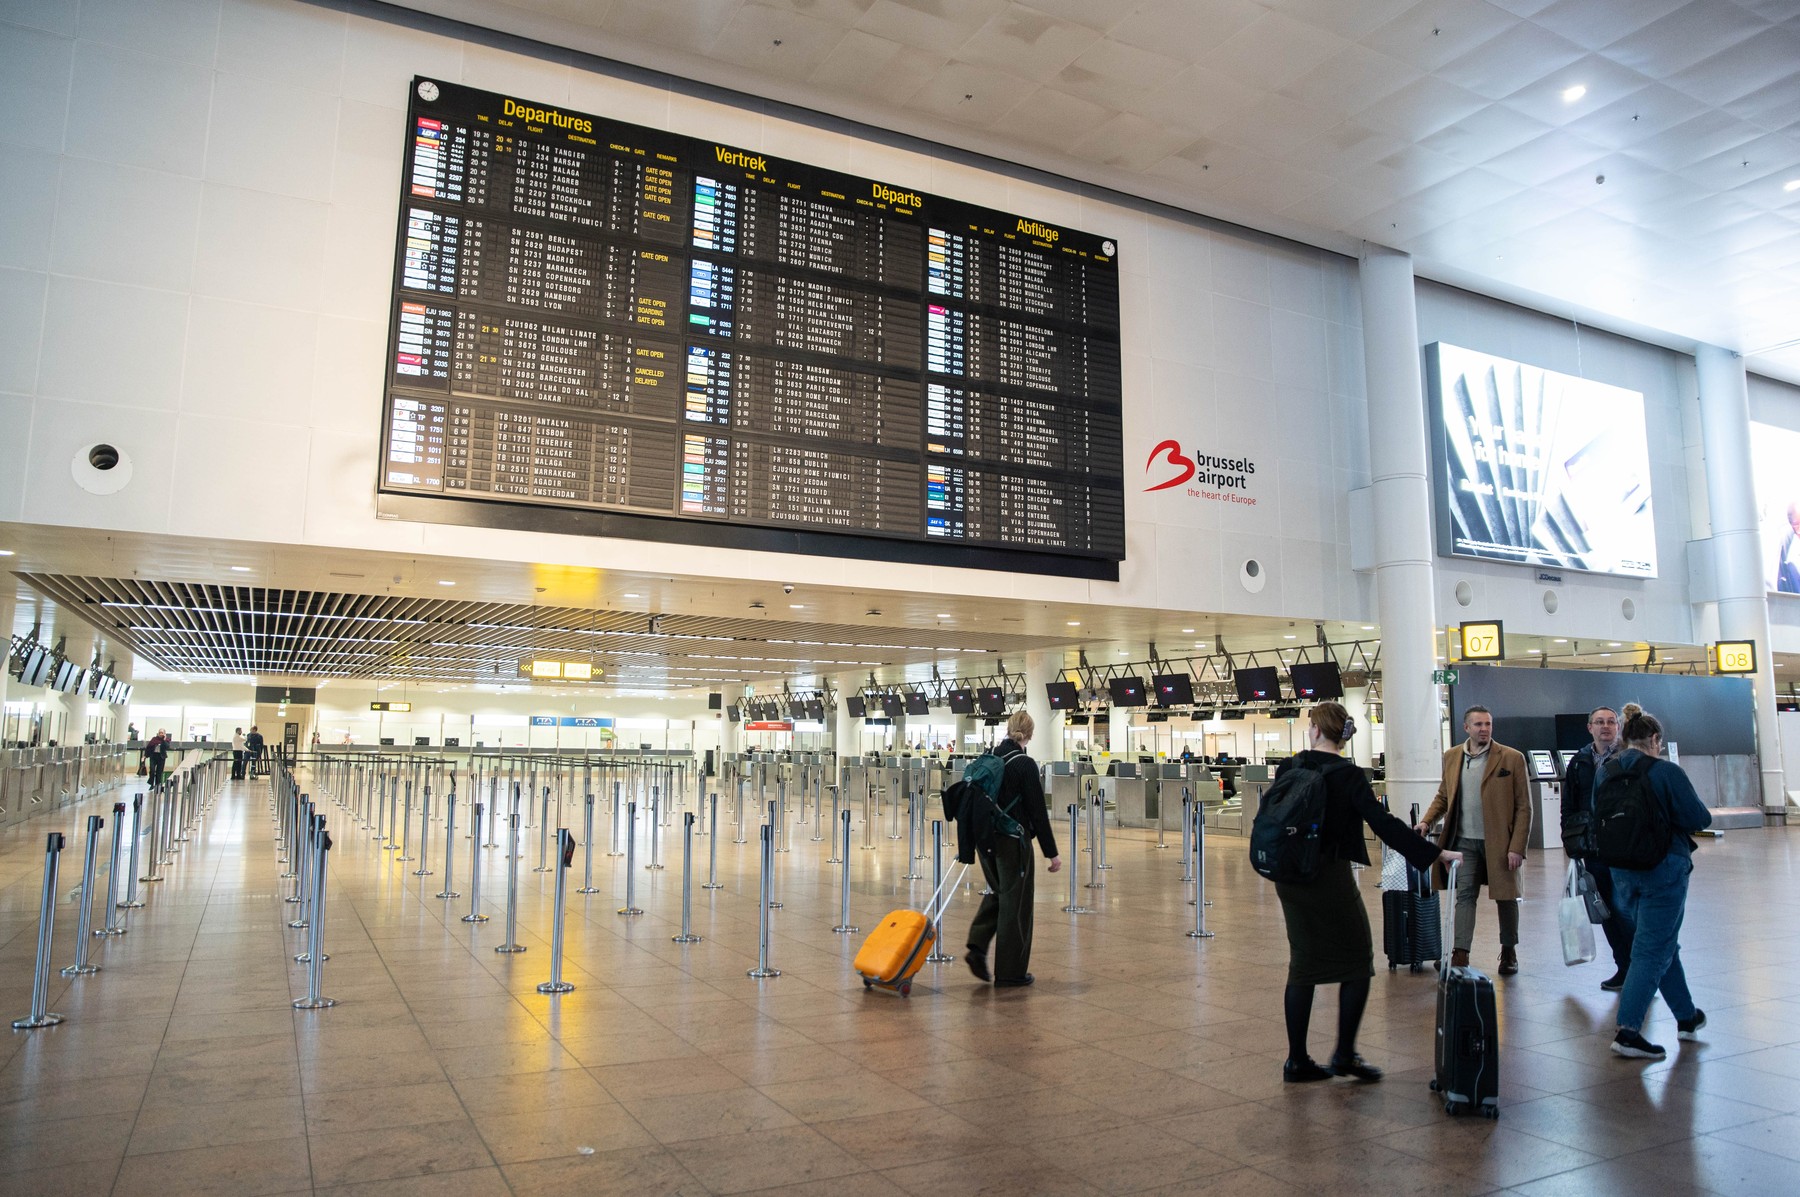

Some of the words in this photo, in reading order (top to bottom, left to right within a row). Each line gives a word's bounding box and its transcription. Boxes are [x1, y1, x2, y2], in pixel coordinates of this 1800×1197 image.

[504, 99, 592, 134] Departures
[477, 114, 489, 122] TIME
[498, 119, 513, 127] DELAY
[568, 134, 596, 145] DESTINATION
[610, 143, 630, 153] CHECK-IN
[634, 148, 646, 156] GATE
[656, 153, 677, 162] REMARKS
[554, 148, 585, 160] TANGIER
[715, 146, 767, 172] Vertrek
[553, 157, 580, 168] WARSAW
[552, 166, 580, 177] MALAGA
[646, 166, 658, 175] GATE
[659, 168, 672, 178] OPEN
[553, 175, 579, 186] ZAGREB
[552, 184, 578, 195] PRAGUE
[551, 193, 592, 206] STOCKHOLM
[872, 183, 922, 208] Départs
[550, 203, 578, 213] WARSAW
[810, 202, 833, 213] GENEVA
[550, 212, 568, 221] ROME
[572, 216, 602, 227] FIUMICI
[810, 211, 829, 221] MILAN
[832, 216, 855, 226] MALPEN
[810, 220, 833, 230] AGADIR
[1017, 218, 1059, 242] Abflüge
[810, 228, 829, 237] PARIS
[548, 235, 576, 246] BERLIN
[810, 236, 832, 246] VIENNA
[547, 245, 583, 256] BUDAPEST
[810, 244, 832, 255] ZURICH
[546, 254, 574, 264] MADRID
[809, 253, 832, 263] MUNICH
[546, 263, 587, 276] MARRAKECH
[809, 262, 843, 274] FRANKFURT
[546, 273, 590, 286] COPENHAGEN
[545, 282, 581, 294] GOTEBORG
[808, 283, 831, 292] MADRID
[544, 292, 576, 303] HAMBURG
[808, 291, 823, 301] ROME
[827, 295, 853, 306] FIUMICI
[544, 302, 562, 310] LYON
[808, 300, 838, 311] HELSINKI
[637, 306, 663, 317] BOARDING
[808, 308, 826, 318] MILAN
[830, 313, 853, 323] LINATE
[637, 316, 650, 324] GATE
[651, 318, 665, 326] OPEN
[808, 318, 853, 331] FUERTEVENTUR
[542, 325, 565, 335] MILAN
[570, 329, 596, 339] LINATE
[808, 326, 842, 338] LANZAROTE
[542, 335, 569, 345] LONDON
[574, 340, 588, 348] LHR
[807, 335, 842, 346] MARRAKECH
[542, 344, 578, 356] TOULOUSE
[808, 344, 837, 354] ISTANBUL
[540, 354, 568, 364] GENEVA
[540, 364, 586, 377] MANCHESTER
[635, 367, 664, 378] CANCELLED
[807, 365, 830, 375] WARSAW
[539, 374, 580, 386] BARCELONA
[635, 377, 657, 386] DELAYED
[806, 374, 841, 386] AMSTERDAM
[539, 383, 557, 392] ILHA
[562, 386, 571, 394] DO
[575, 388, 589, 396] SAL
[806, 384, 825, 392] PARIS
[515, 390, 533, 399] VIA:
[538, 393, 562, 402] DAKAR
[806, 392, 821, 400] ROME
[825, 395, 851, 405] FIUMICI
[806, 402, 829, 410] PRAGUE
[805, 410, 840, 421] BARCELONA
[536, 418, 569, 428] ANTALYA
[805, 419, 840, 429] FRANKFURT
[536, 428, 564, 438] LISBON
[805, 428, 829, 437] GENEVA
[536, 438, 573, 449] TENERIFE
[535, 448, 573, 458] ALICANTE
[804, 451, 828, 460] MUNICH
[535, 458, 563, 467] MALAGA
[804, 460, 828, 469] DUBLIN
[1197, 450, 1255, 474] brussels
[534, 468, 576, 479] MARRAKECH
[804, 469, 820, 477] ROME
[824, 472, 850, 481] FIUMICI
[1198, 468, 1246, 489] airport
[510, 475, 529, 484] VIA:
[534, 478, 562, 487] AGADIR
[533, 488, 575, 499] AMSTERDAM
[804, 488, 827, 496] MADRID
[1188, 488, 1200, 498] the
[1201, 490, 1221, 500] heart
[1222, 492, 1230, 502] of
[1231, 494, 1256, 506] Europe
[804, 496, 831, 506] TALLINN
[803, 506, 823, 514] MILAN
[827, 508, 850, 517] LINATE
[803, 515, 823, 523] MILAN
[827, 517, 850, 526] LINATE
[1470, 636, 1493, 652] 07
[1725, 653, 1748, 667] 08
